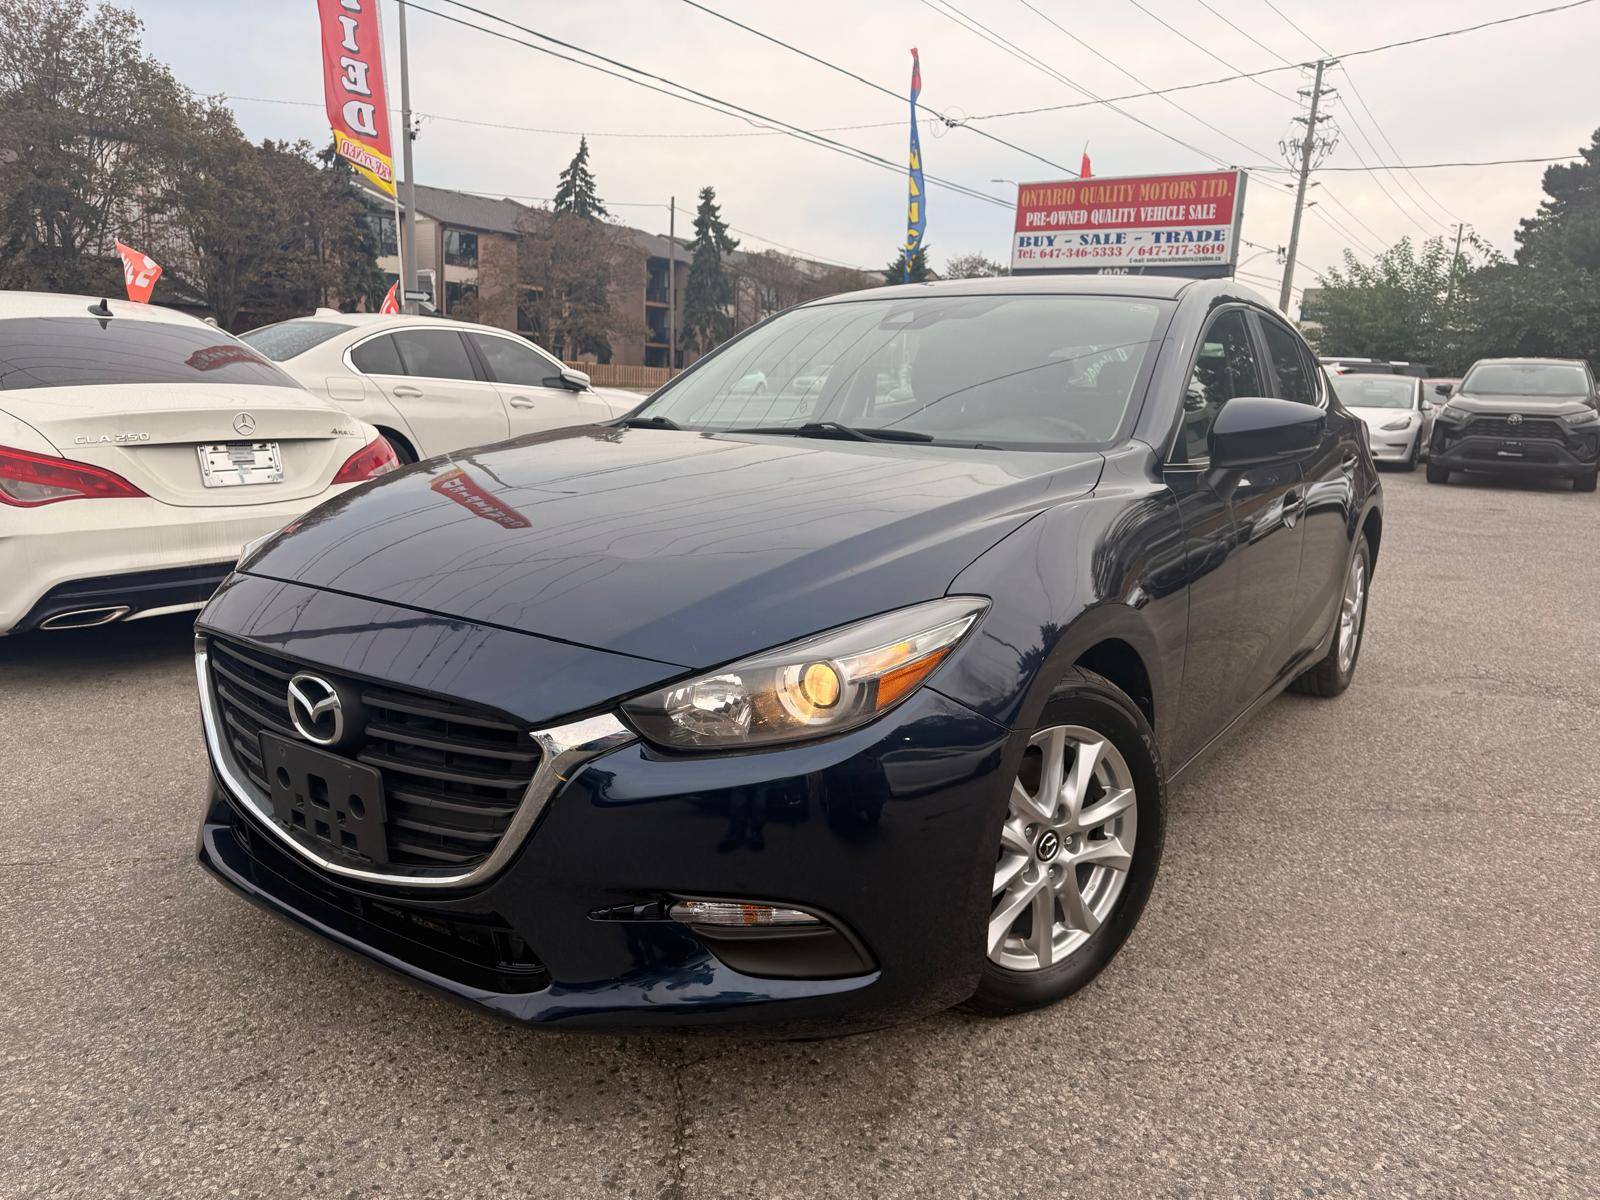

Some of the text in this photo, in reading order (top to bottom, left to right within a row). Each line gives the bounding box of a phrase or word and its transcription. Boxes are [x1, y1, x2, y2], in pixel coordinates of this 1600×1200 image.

[1021, 179, 1232, 207] ONTARIO QUALITY MOTORS LTD.
[1025, 203, 1217, 227] PRE-OWNED QUALITY VEHICLE SALE
[1018, 235, 1057, 247] BUY
[1079, 232, 1127, 246] SALE
[1151, 229, 1225, 243] TRADE
[1017, 249, 1036, 259] Tel:
[1039, 246, 1122, 259] 647-346-5333
[1138, 243, 1225, 257] 647-717-3619
[74, 432, 151, 445] CLA 250
